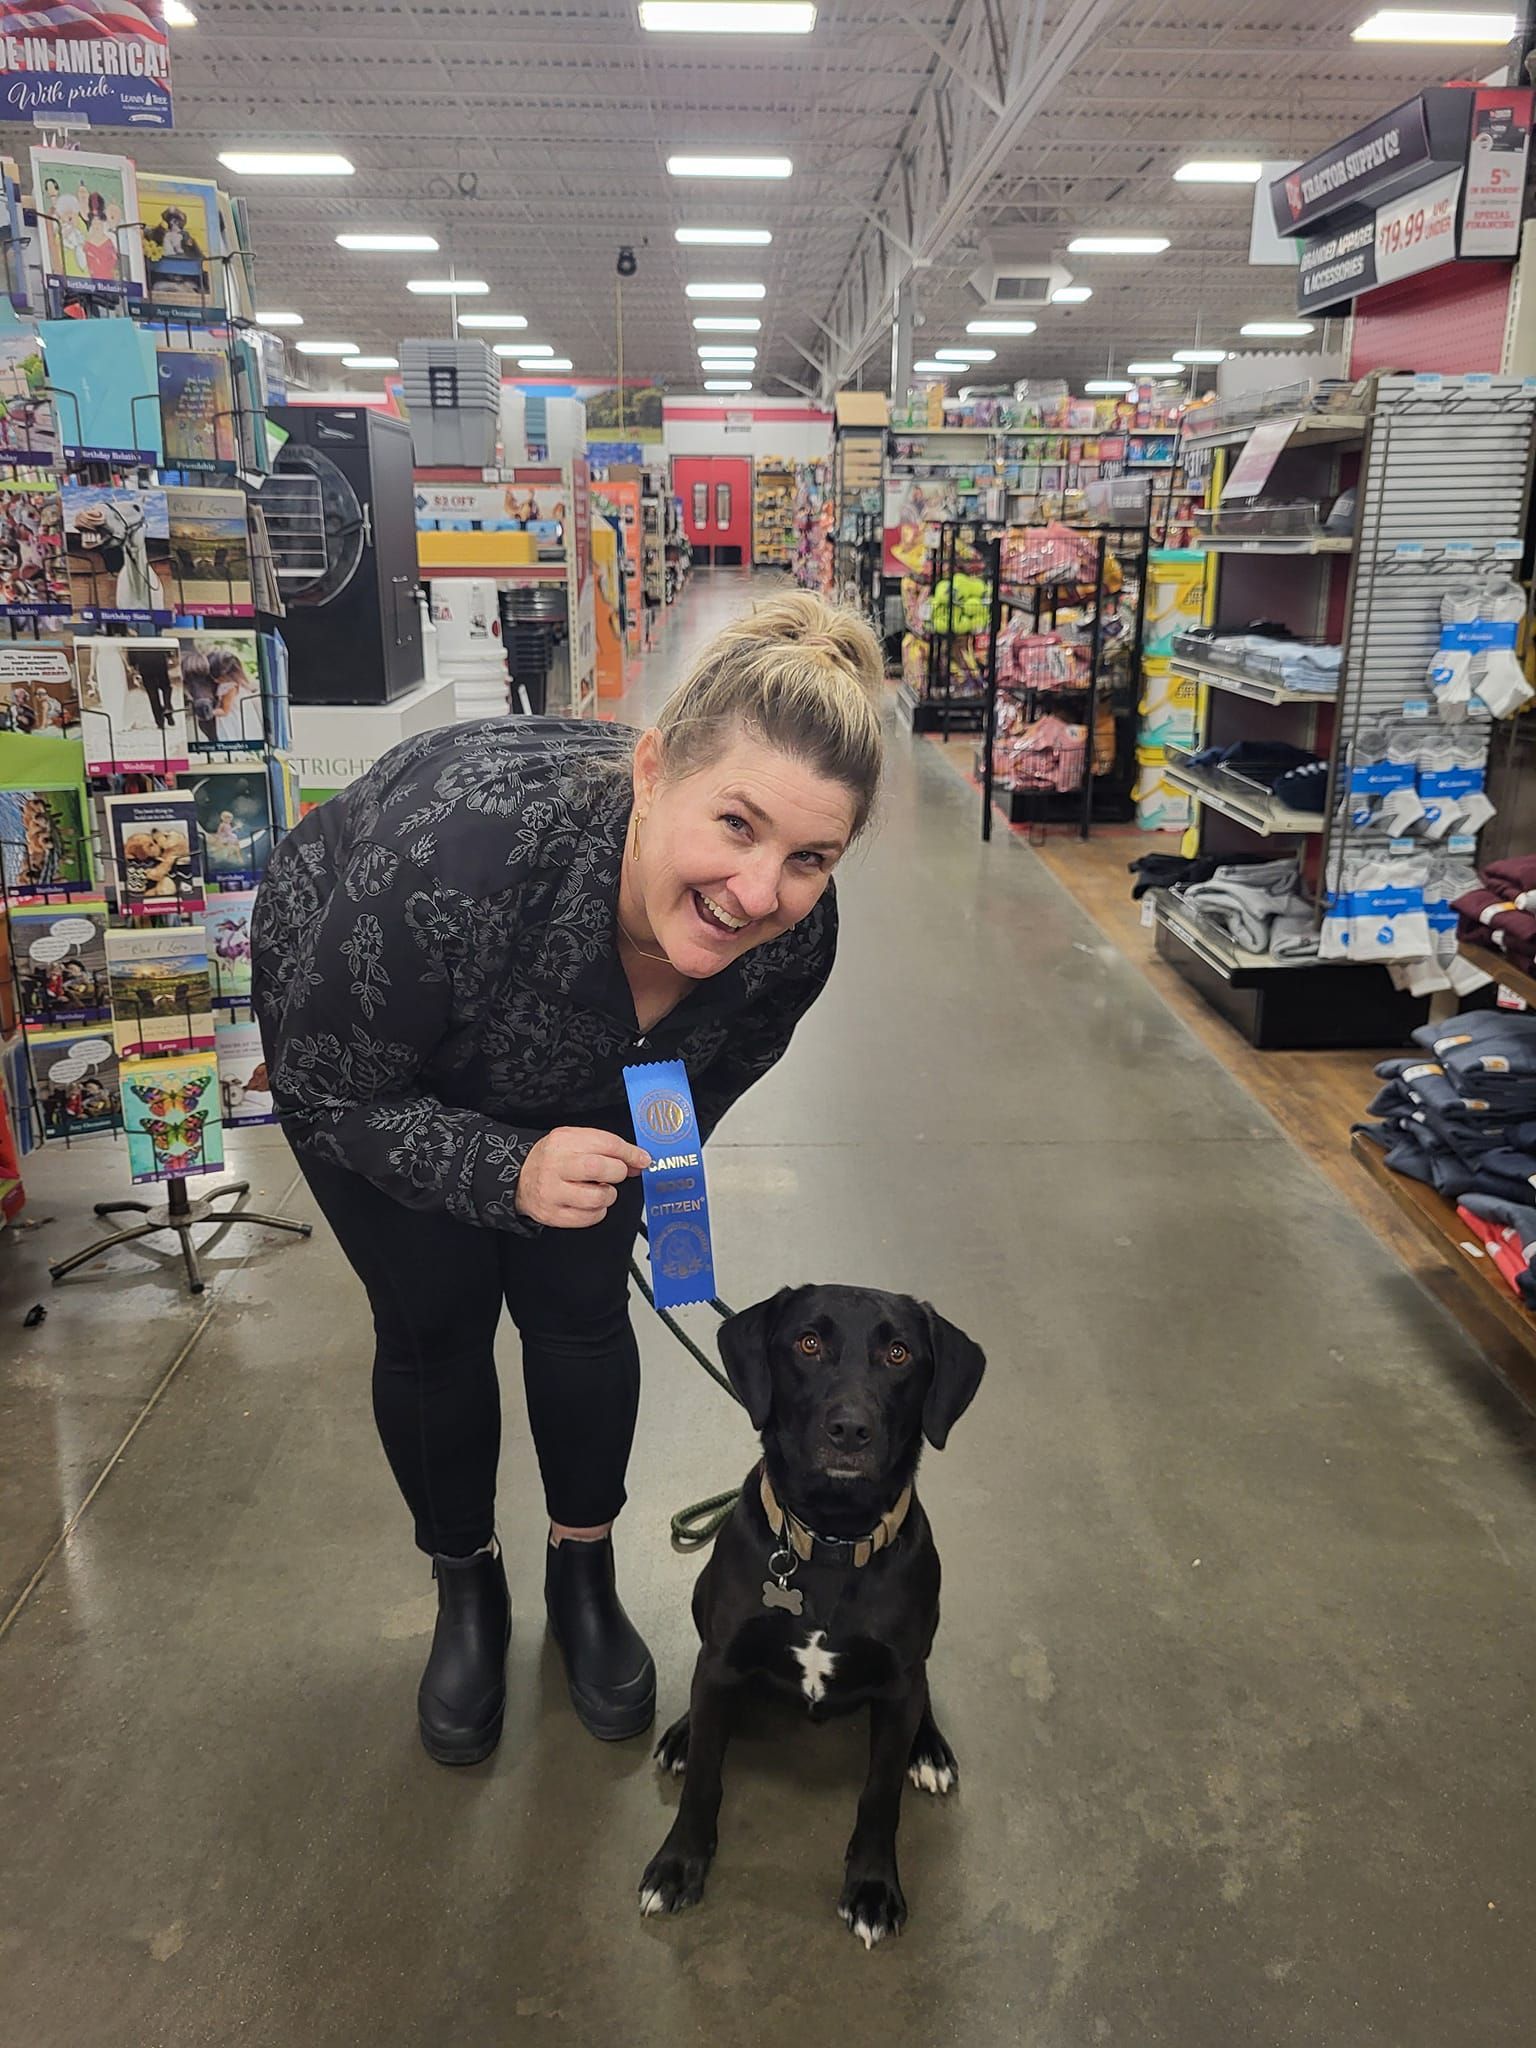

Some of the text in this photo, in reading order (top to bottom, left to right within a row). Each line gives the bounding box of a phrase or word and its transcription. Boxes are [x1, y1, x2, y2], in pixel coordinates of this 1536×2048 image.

[24, 37, 50, 71] IN
[55, 38, 168, 77] AMERICA!
[8, 75, 115, 110] With pride.
[1301, 160, 1348, 204] TRACTOR
[1345, 137, 1386, 180] SUPPLY
[1335, 222, 1375, 258] APPAREL
[1311, 254, 1365, 294] ACCESSORIES
[176, 461, 216, 471] Friendship
[6, 607, 39, 616] Birthday
[648, 1153, 699, 1173] CANINE
